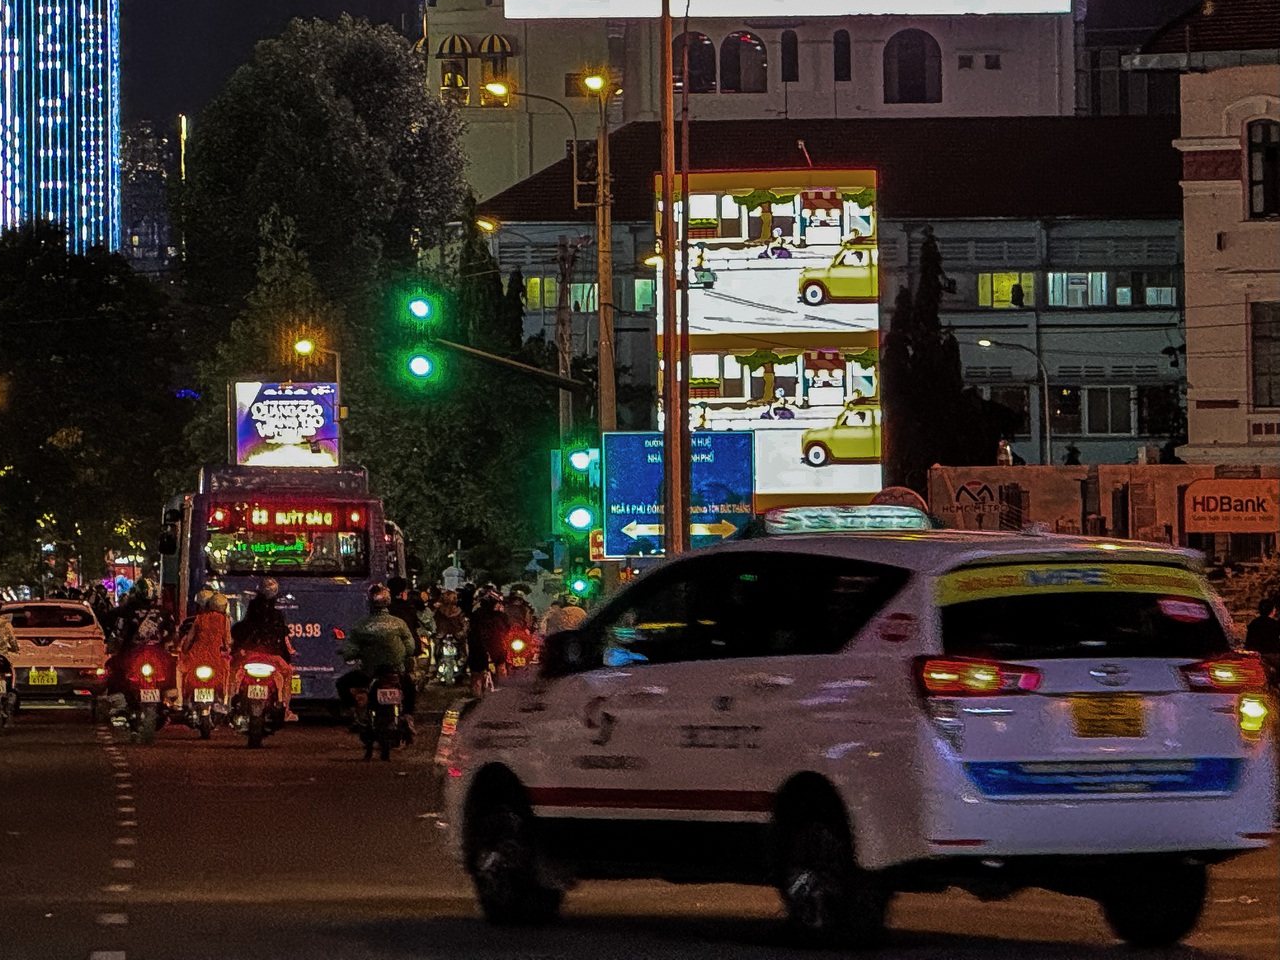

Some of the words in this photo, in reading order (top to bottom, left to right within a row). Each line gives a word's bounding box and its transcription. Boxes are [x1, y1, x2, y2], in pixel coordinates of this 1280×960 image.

[631, 501, 646, 514] PHÙ
[942, 504, 971, 513] HCMC
[972, 503, 1009, 513] METRO
[1192, 495, 1267, 512] HDBank
